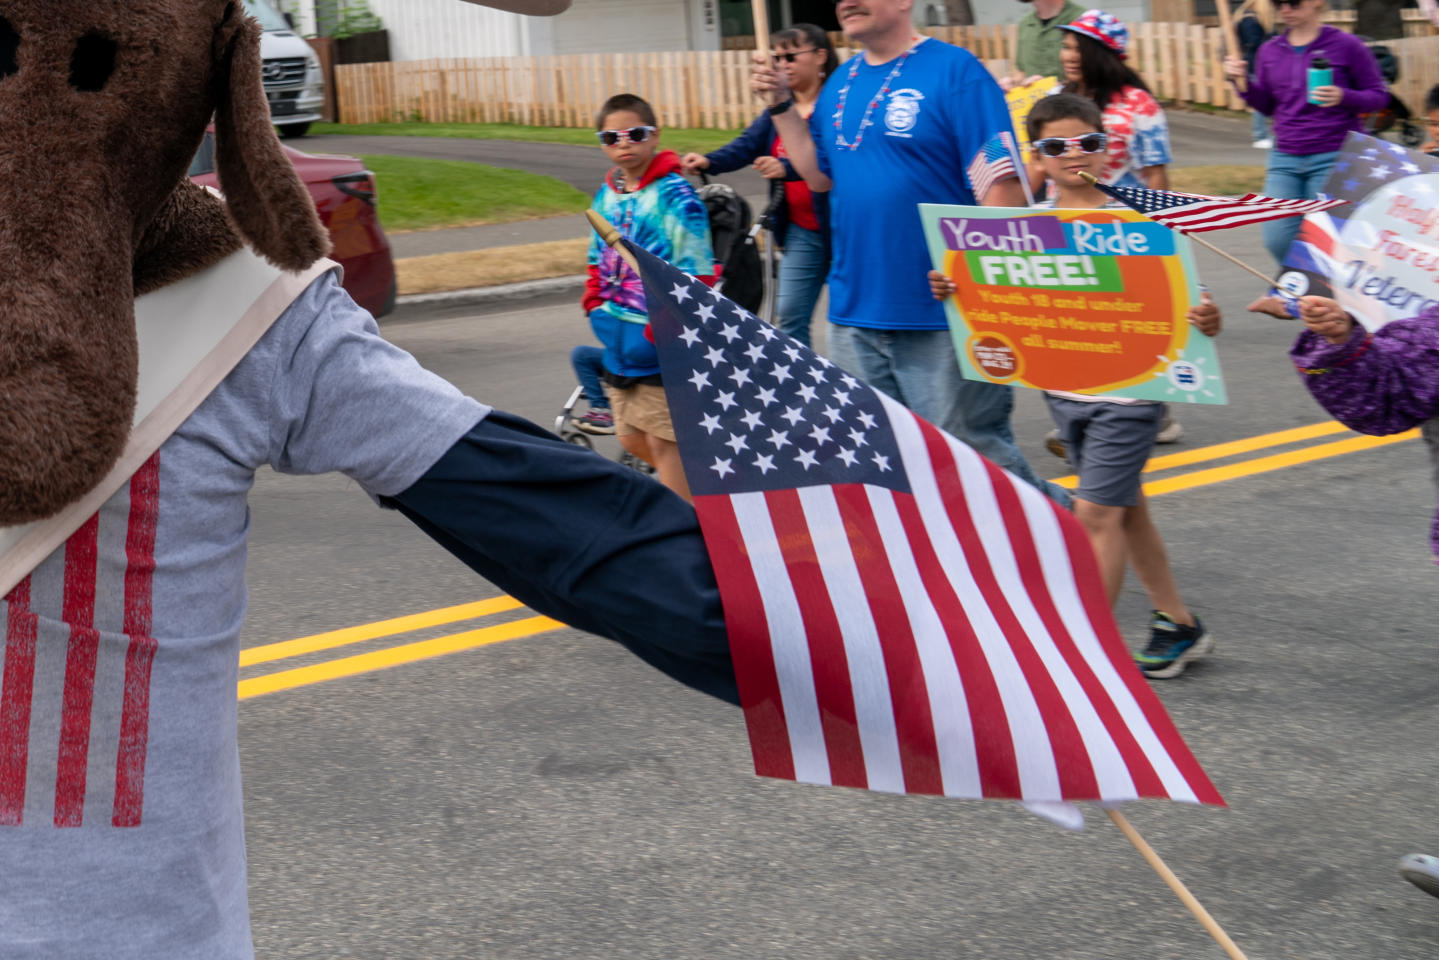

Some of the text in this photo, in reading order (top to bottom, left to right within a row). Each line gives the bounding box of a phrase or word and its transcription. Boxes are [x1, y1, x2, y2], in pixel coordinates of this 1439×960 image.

[942, 218, 1150, 256] Youth Ride
[979, 255, 1100, 286] FREE!
[977, 289, 1030, 306] Youth
[1052, 295, 1087, 310] and
[1088, 298, 1145, 313] under
[999, 311, 1058, 330] People
[1058, 316, 1118, 332] Mover
[1119, 320, 1174, 335] FREE
[1021, 334, 1045, 348] all
